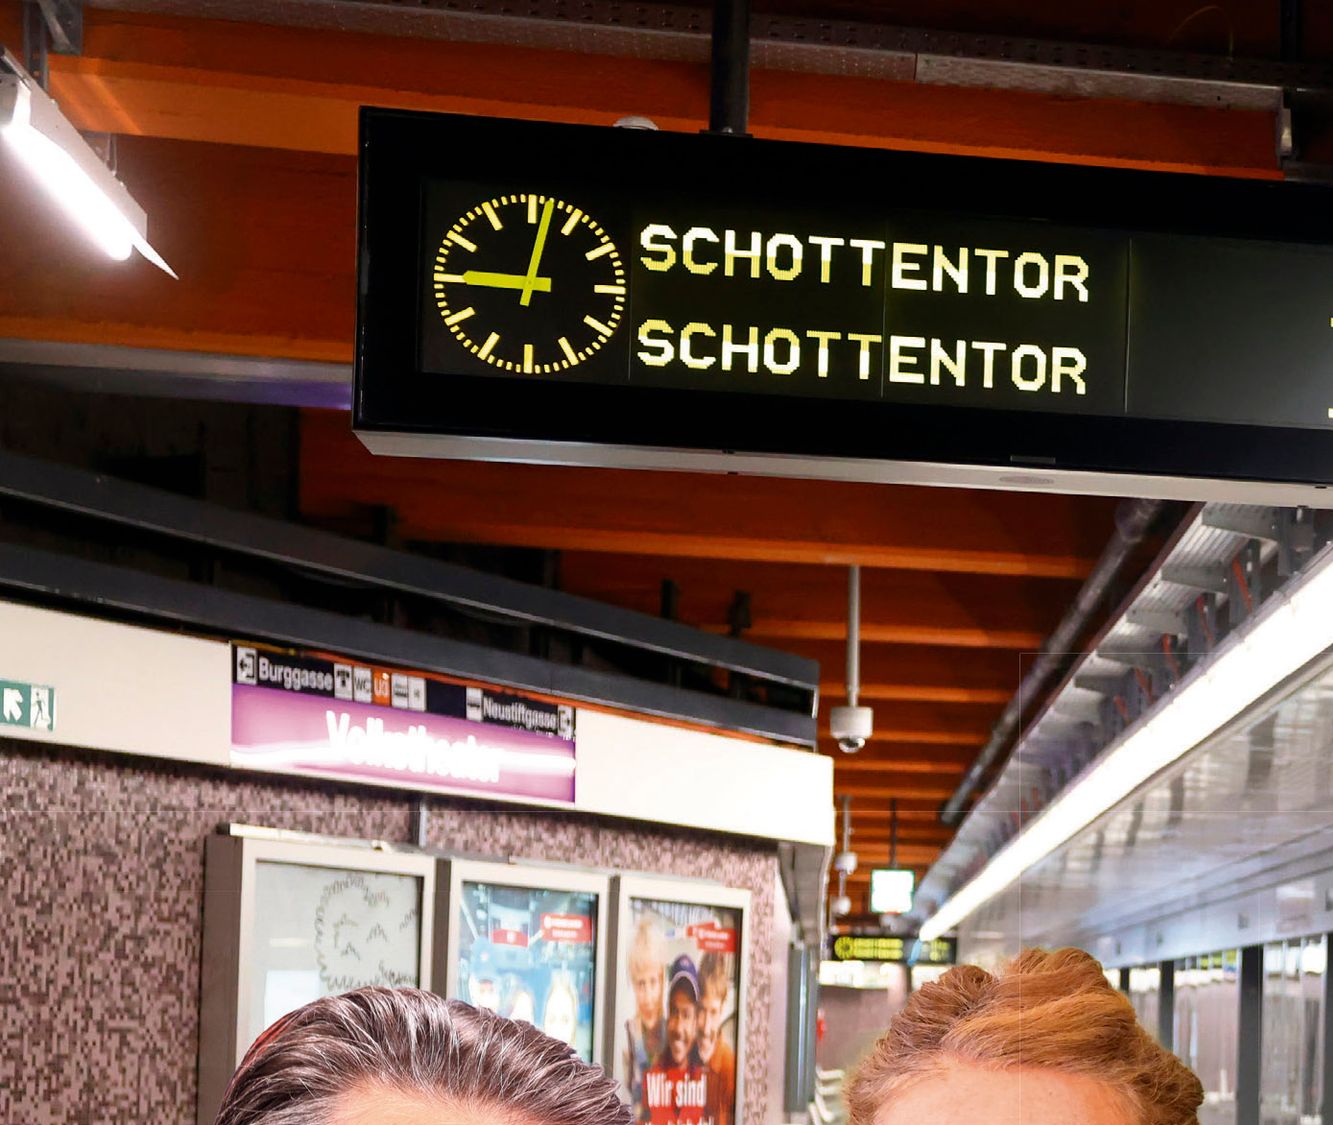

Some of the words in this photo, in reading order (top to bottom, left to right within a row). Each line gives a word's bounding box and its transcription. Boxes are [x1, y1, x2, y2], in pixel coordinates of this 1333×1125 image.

[640, 224, 1089, 302] SCHOTTENTOR
[637, 319, 1087, 395] SCHOTTENTOR
[258, 657, 333, 691] Burggasse
[483, 695, 557, 731] Neustiftgasse
[646, 1072, 673, 1108] Wir
[675, 1072, 707, 1108] sind
